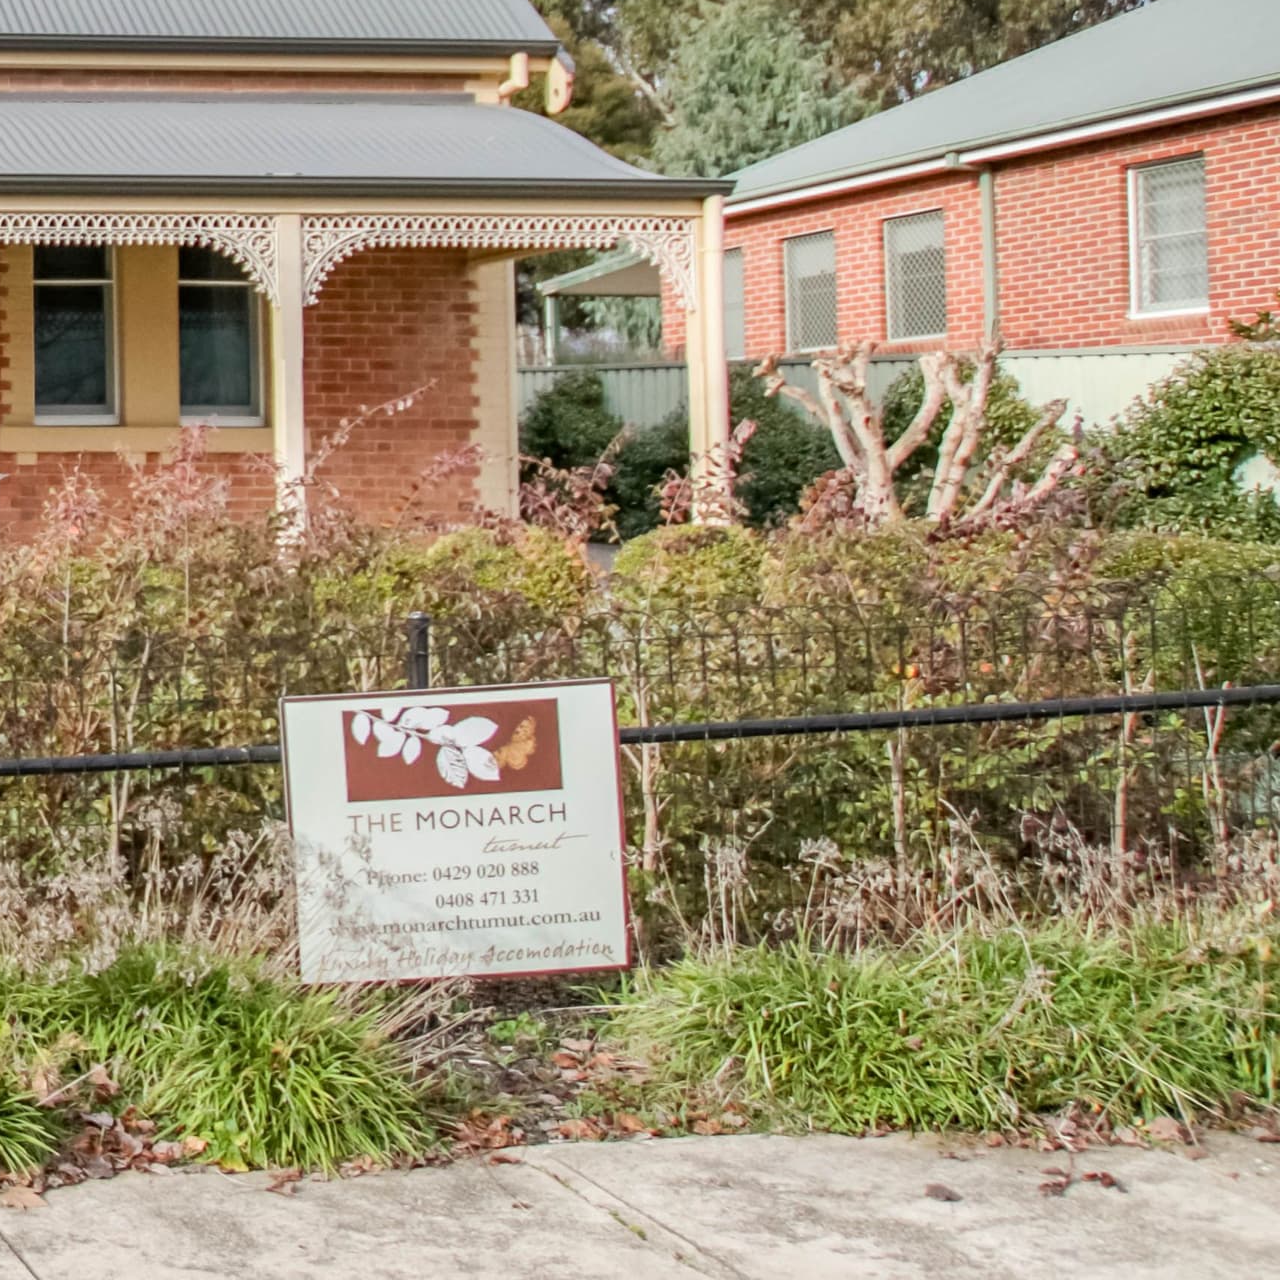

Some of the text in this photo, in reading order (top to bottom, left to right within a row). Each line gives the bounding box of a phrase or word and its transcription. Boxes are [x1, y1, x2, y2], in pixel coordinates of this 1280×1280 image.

[347, 801, 567, 835] THE MONARCH
[482, 831, 590, 854] tumut
[432, 865, 472, 882] 0429
[476, 863, 506, 879] 020
[511, 860, 540, 877] 888
[435, 887, 540, 909] 0408 471 331
